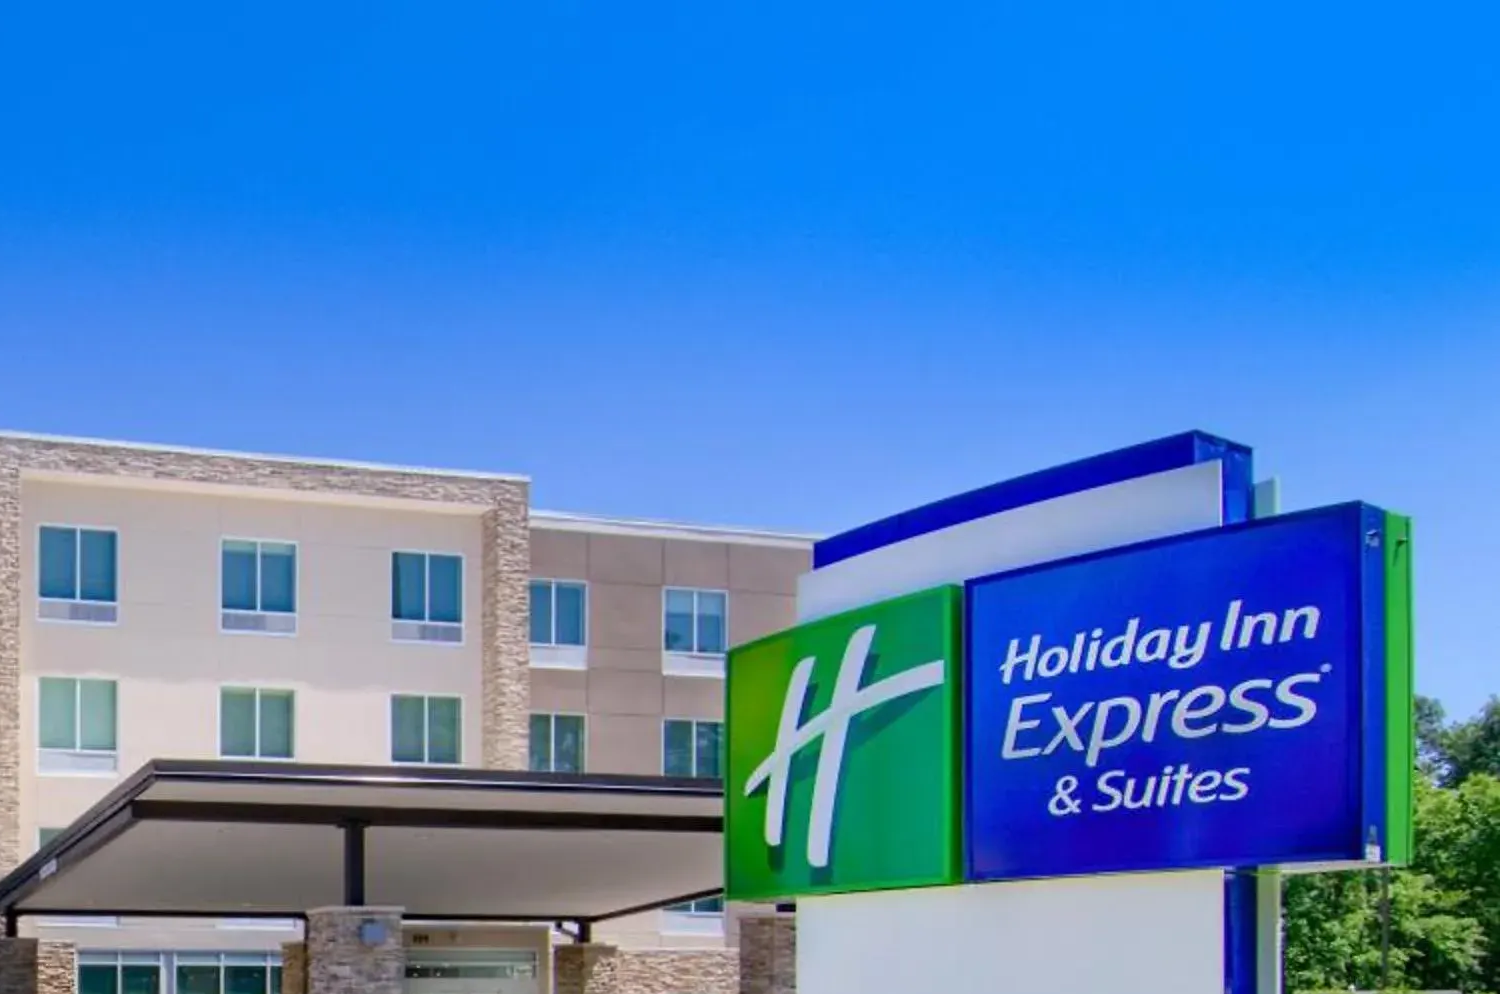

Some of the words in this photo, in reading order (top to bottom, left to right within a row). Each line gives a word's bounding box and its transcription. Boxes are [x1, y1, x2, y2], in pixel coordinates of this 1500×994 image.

[1000, 618, 1211, 684] Holiday
[1221, 600, 1320, 650] Inn
[1002, 673, 1321, 767] Express
[1048, 775, 1081, 816] &
[1092, 764, 1250, 811] Suites
